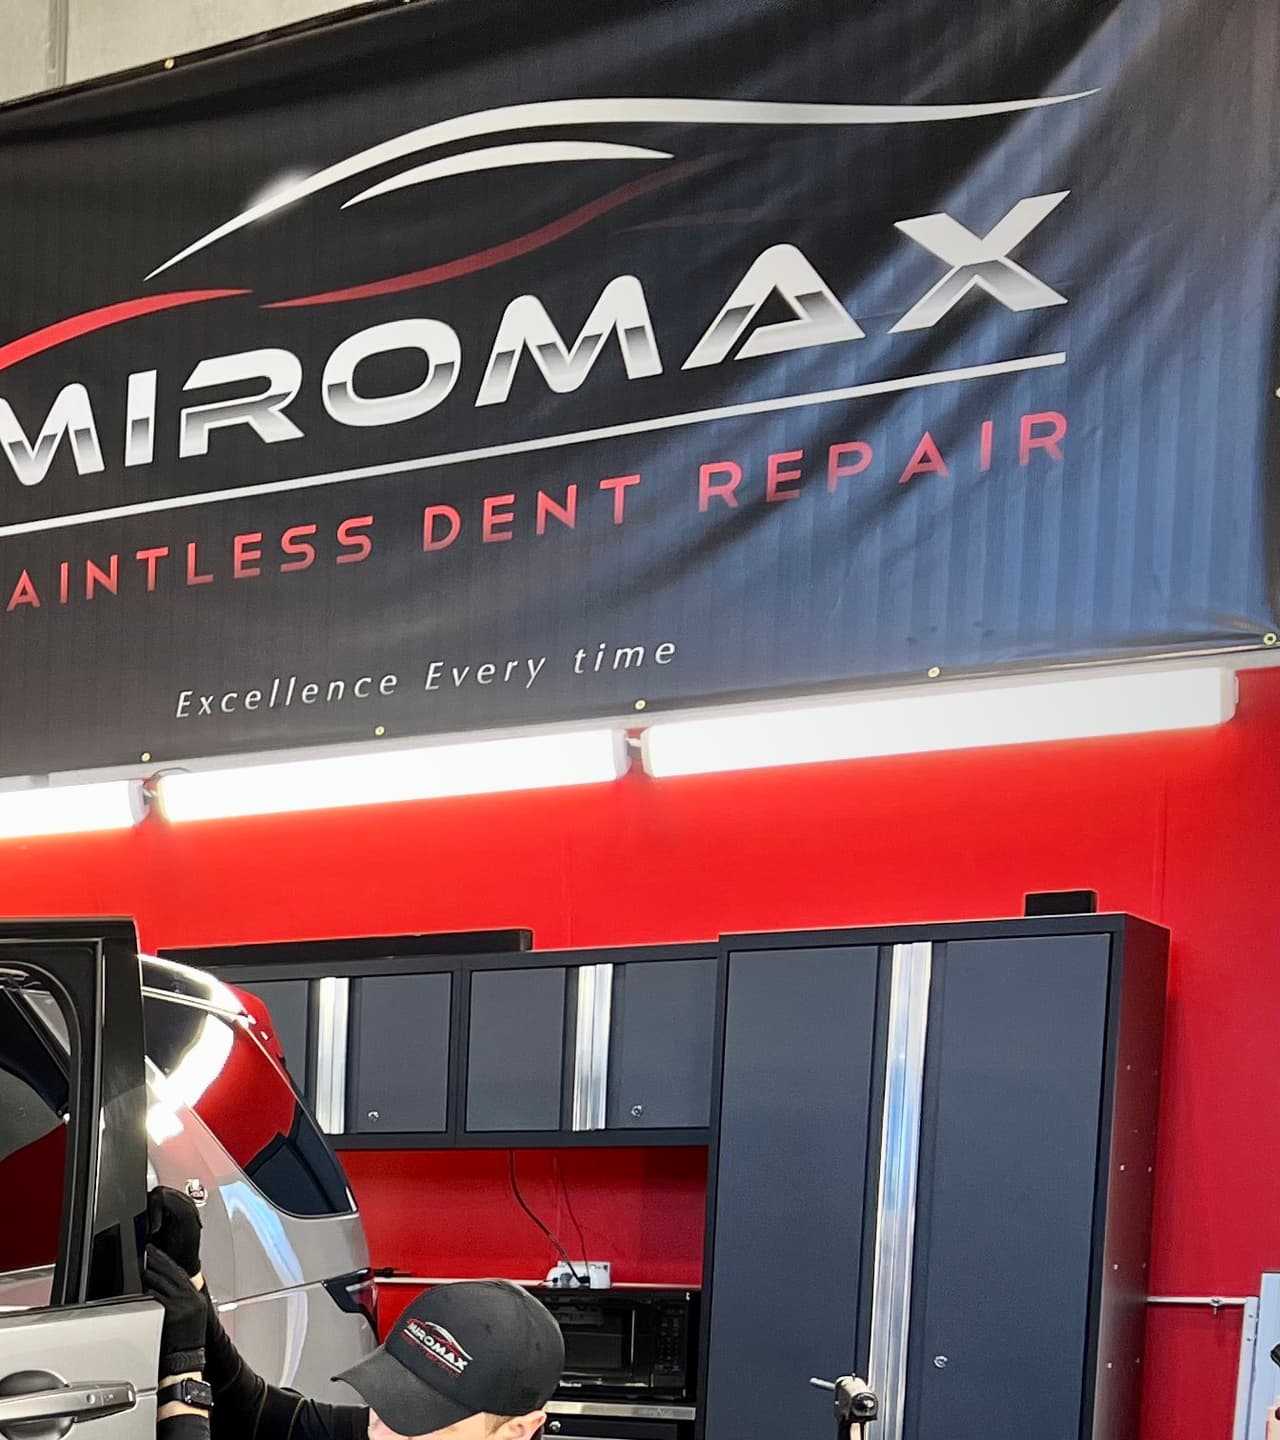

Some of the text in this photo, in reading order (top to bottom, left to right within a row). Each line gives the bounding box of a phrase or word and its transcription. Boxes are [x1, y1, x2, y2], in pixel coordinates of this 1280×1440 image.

[423, 474, 640, 552] DENT
[699, 411, 1068, 512] REPAIR
[175, 641, 677, 718] Excellence Every time
[408, 1322, 468, 1370] MIROMAX
